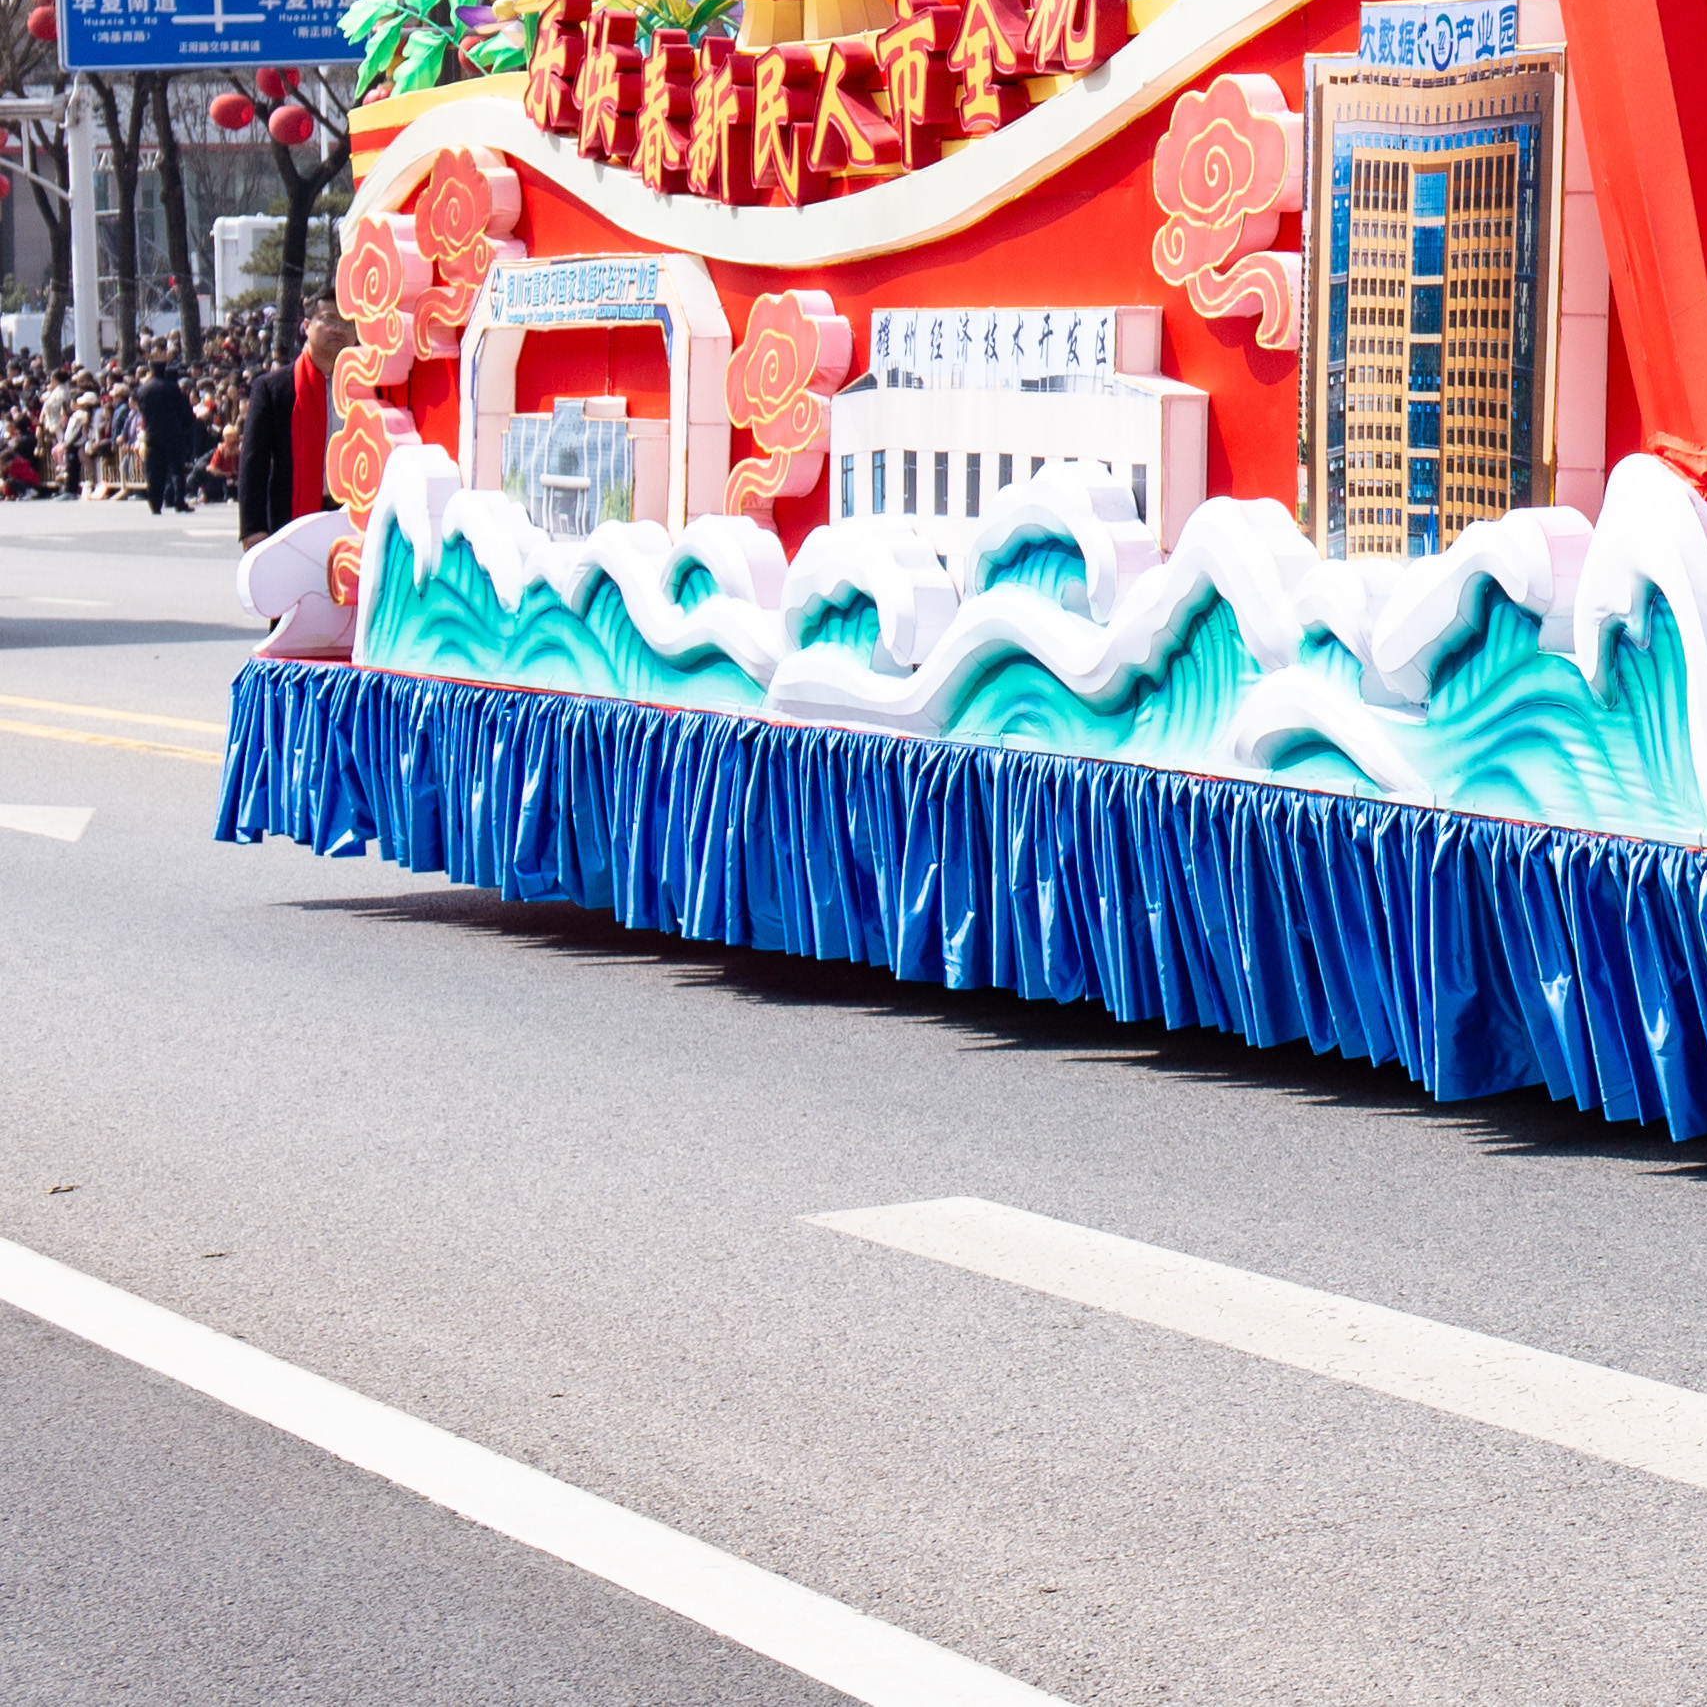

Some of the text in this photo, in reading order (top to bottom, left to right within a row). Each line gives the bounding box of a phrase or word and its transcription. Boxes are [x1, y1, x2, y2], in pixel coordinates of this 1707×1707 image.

[83, 17, 125, 27] Huaxia
[143, 16, 158, 25] Rd
[278, 12, 318, 23] Huaxia
[1359, 4, 1518, 66] 大数据 产业园
[876, 311, 1108, 368] 耀州经济技术开发区
